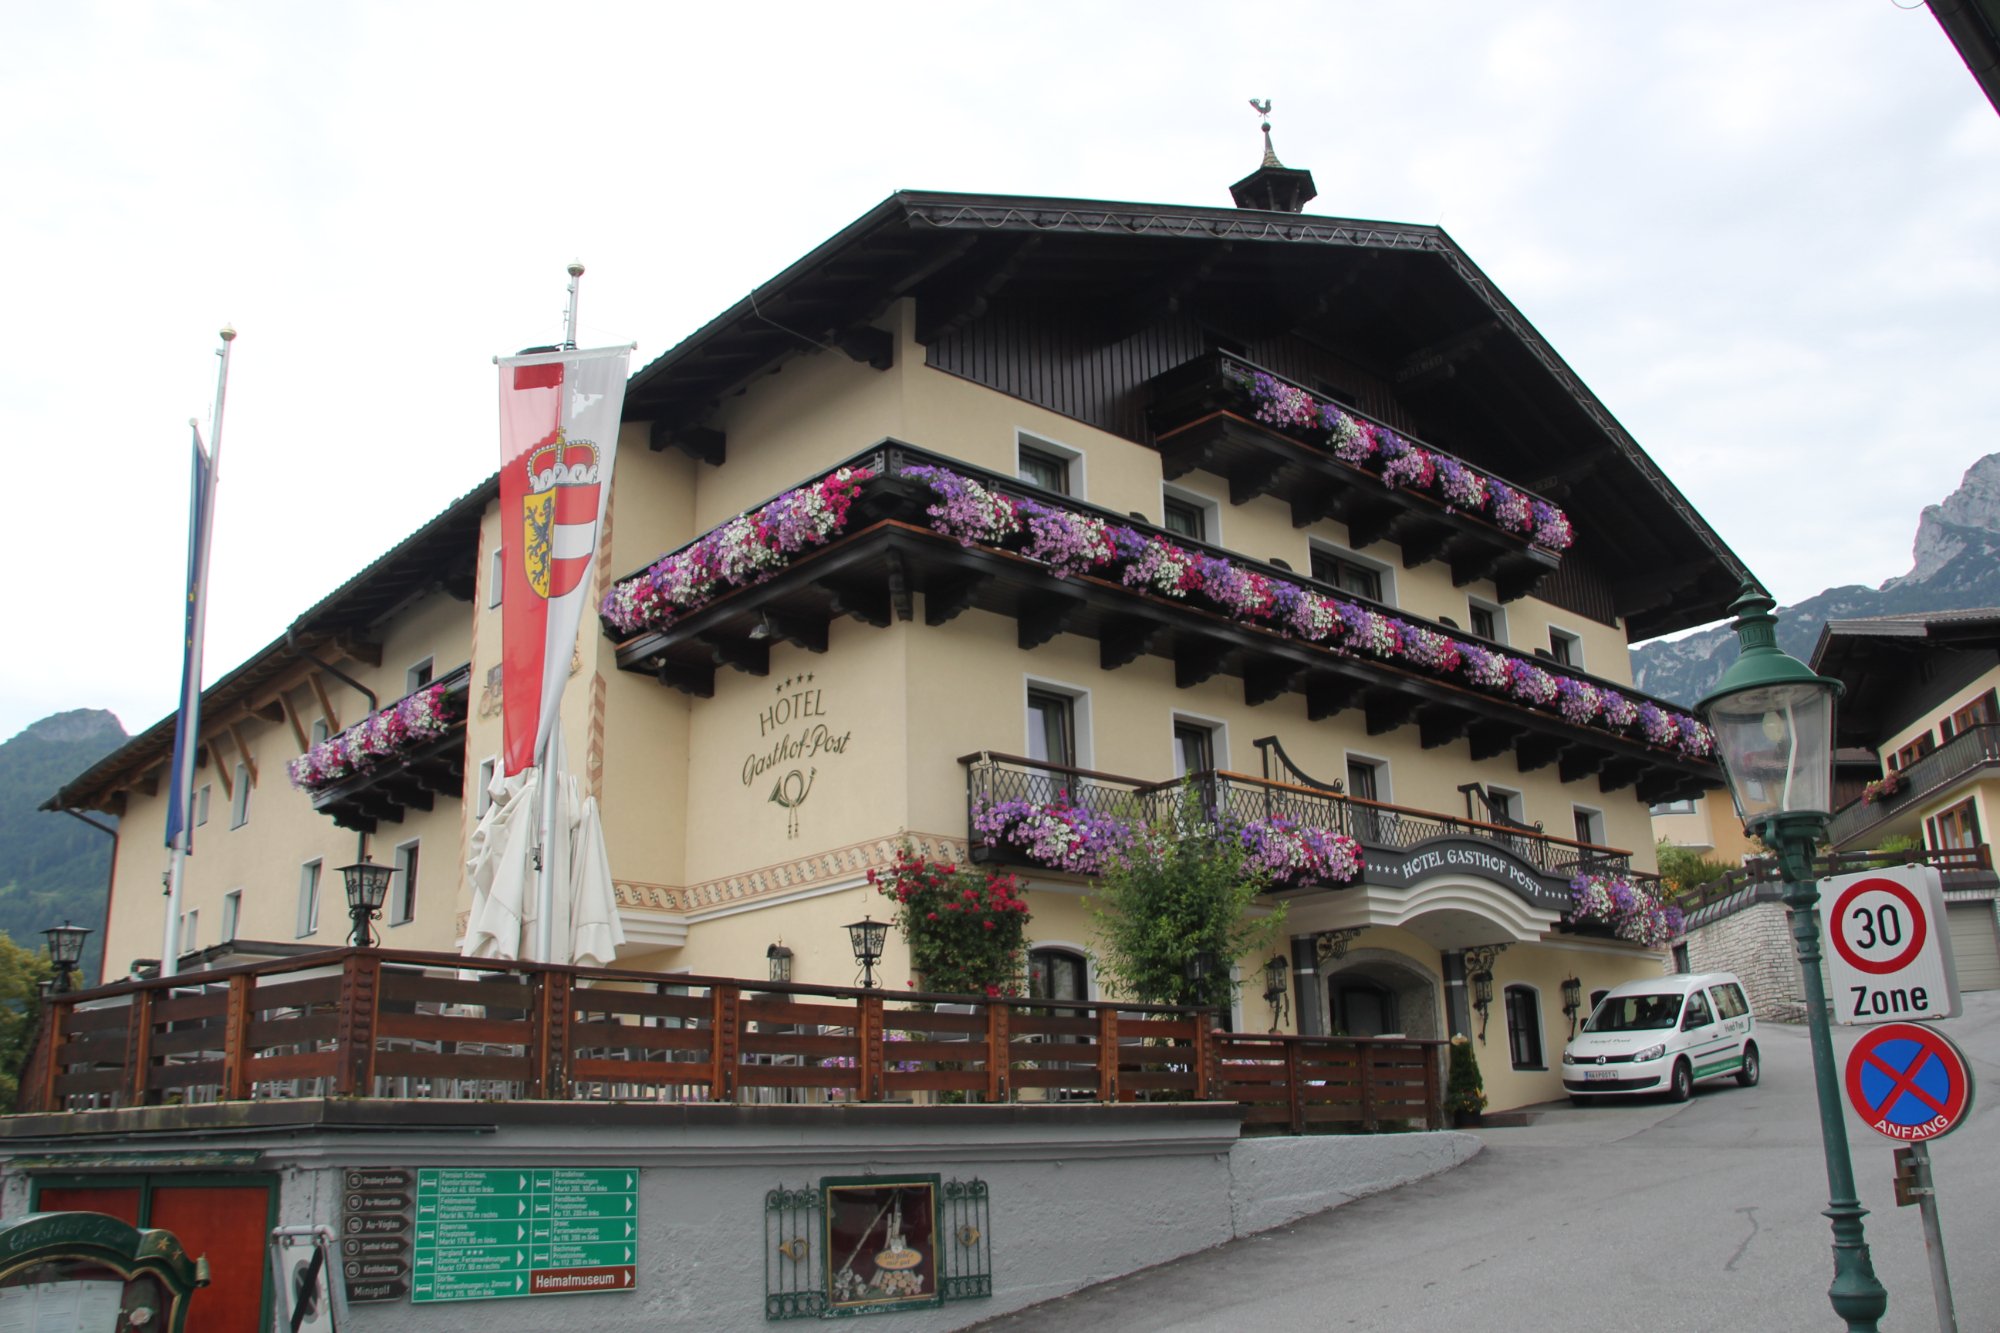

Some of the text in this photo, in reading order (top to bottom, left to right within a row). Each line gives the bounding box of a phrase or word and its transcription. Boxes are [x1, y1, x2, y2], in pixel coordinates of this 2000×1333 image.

[760, 689, 826, 737] HOTEL
[1402, 849, 1542, 897] HOTEL GASTHOF POST
[1852, 904, 1902, 950] 30
[1850, 984, 1929, 1017] Zone
[1874, 1114, 1950, 1139] ANFANG
[366, 1219, 400, 1231] Au-Voglau
[354, 1285, 390, 1298] Minigolf
[536, 1274, 615, 1288] Heimatmuseum
